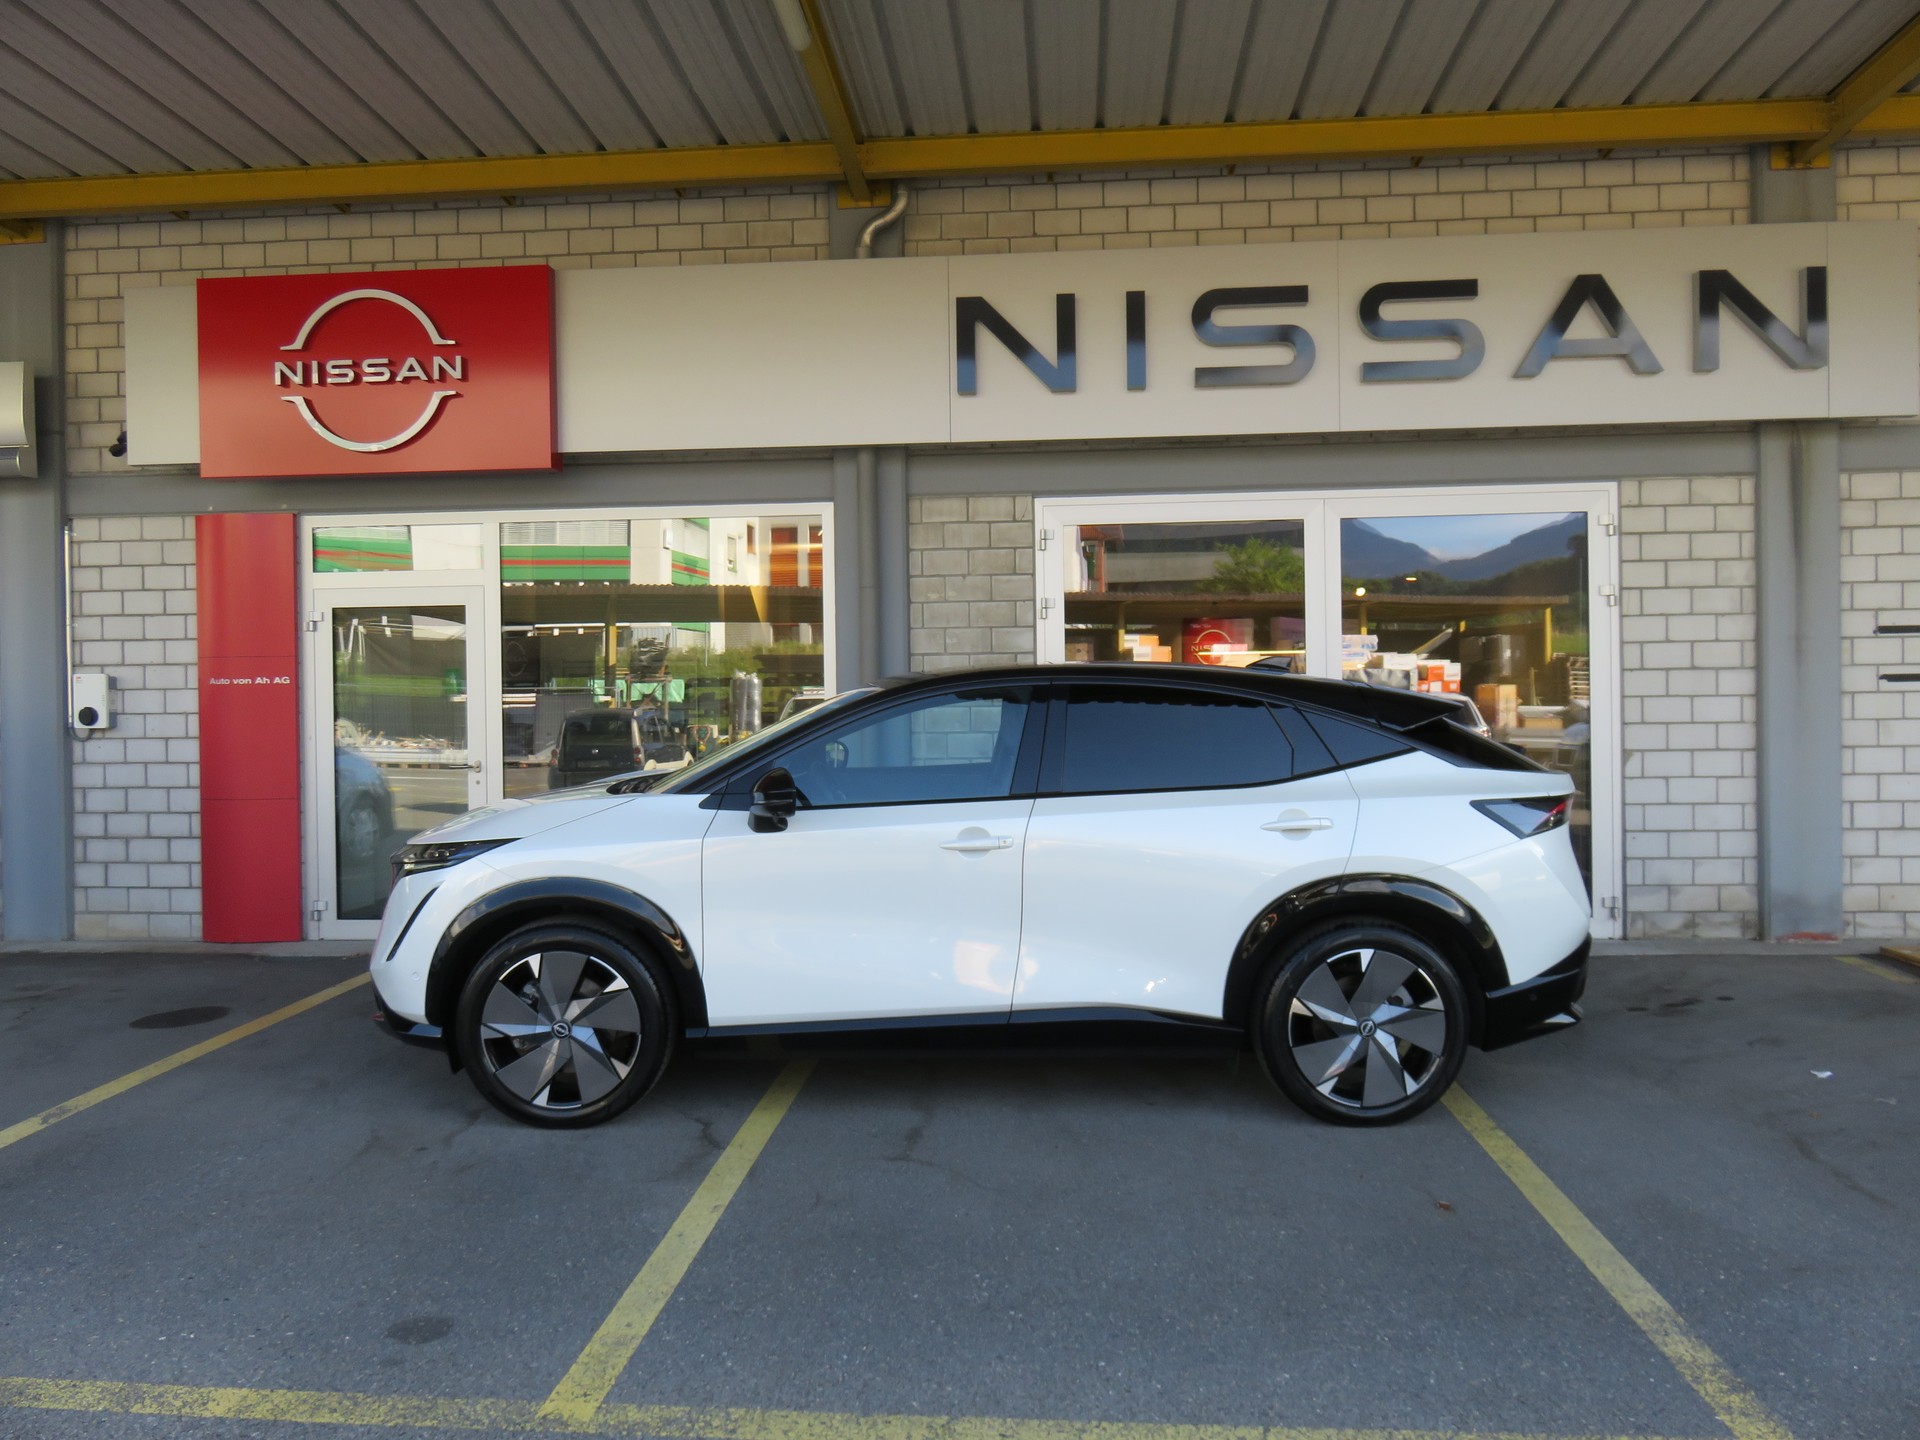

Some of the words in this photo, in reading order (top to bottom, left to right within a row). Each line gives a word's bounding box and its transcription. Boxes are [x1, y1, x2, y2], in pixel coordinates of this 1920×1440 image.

[955, 266, 1828, 396] NISSAN
[274, 355, 463, 386] NISSAN
[209, 677, 231, 685] Auto
[254, 676, 271, 684] Ah
[273, 675, 291, 684] AG
